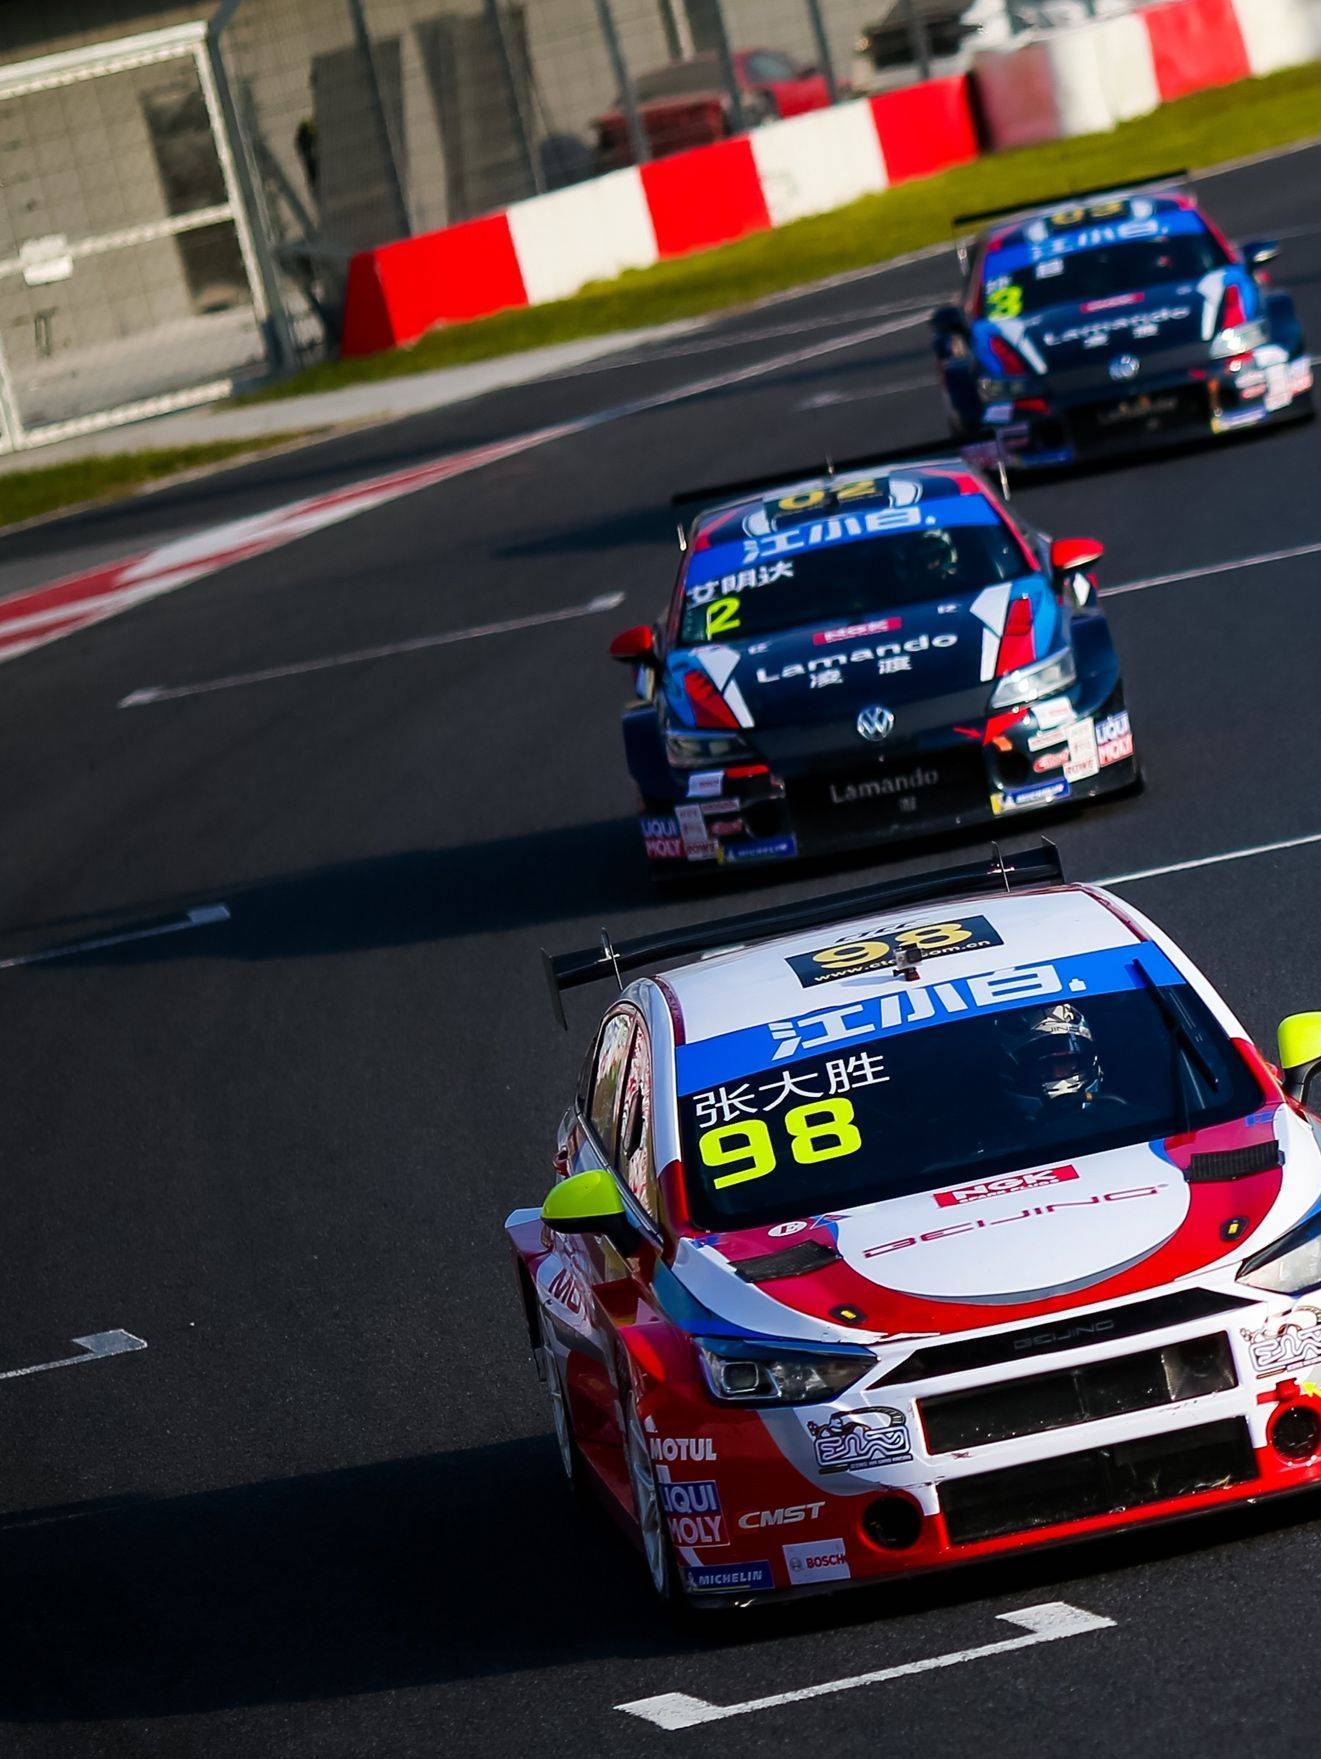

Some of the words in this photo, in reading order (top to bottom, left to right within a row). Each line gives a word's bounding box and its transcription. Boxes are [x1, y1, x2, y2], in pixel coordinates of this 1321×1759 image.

[987, 285, 1023, 319] 3
[706, 597, 741, 636] 2
[756, 634, 958, 683] Lamando
[829, 767, 938, 804] Lamando
[812, 923, 972, 968] 98
[693, 1052, 890, 1128] 张大胜
[699, 1098, 862, 1189] 98
[951, 1169, 1057, 1199] NGK
[863, 1186, 1158, 1258] BEIJING
[650, 1438, 717, 1461] MOTUL
[664, 1484, 717, 1513] IQUI
[738, 1501, 826, 1529] CMST
[698, 1570, 762, 1585] MICHELIN
[806, 1554, 845, 1569] BOSCH
